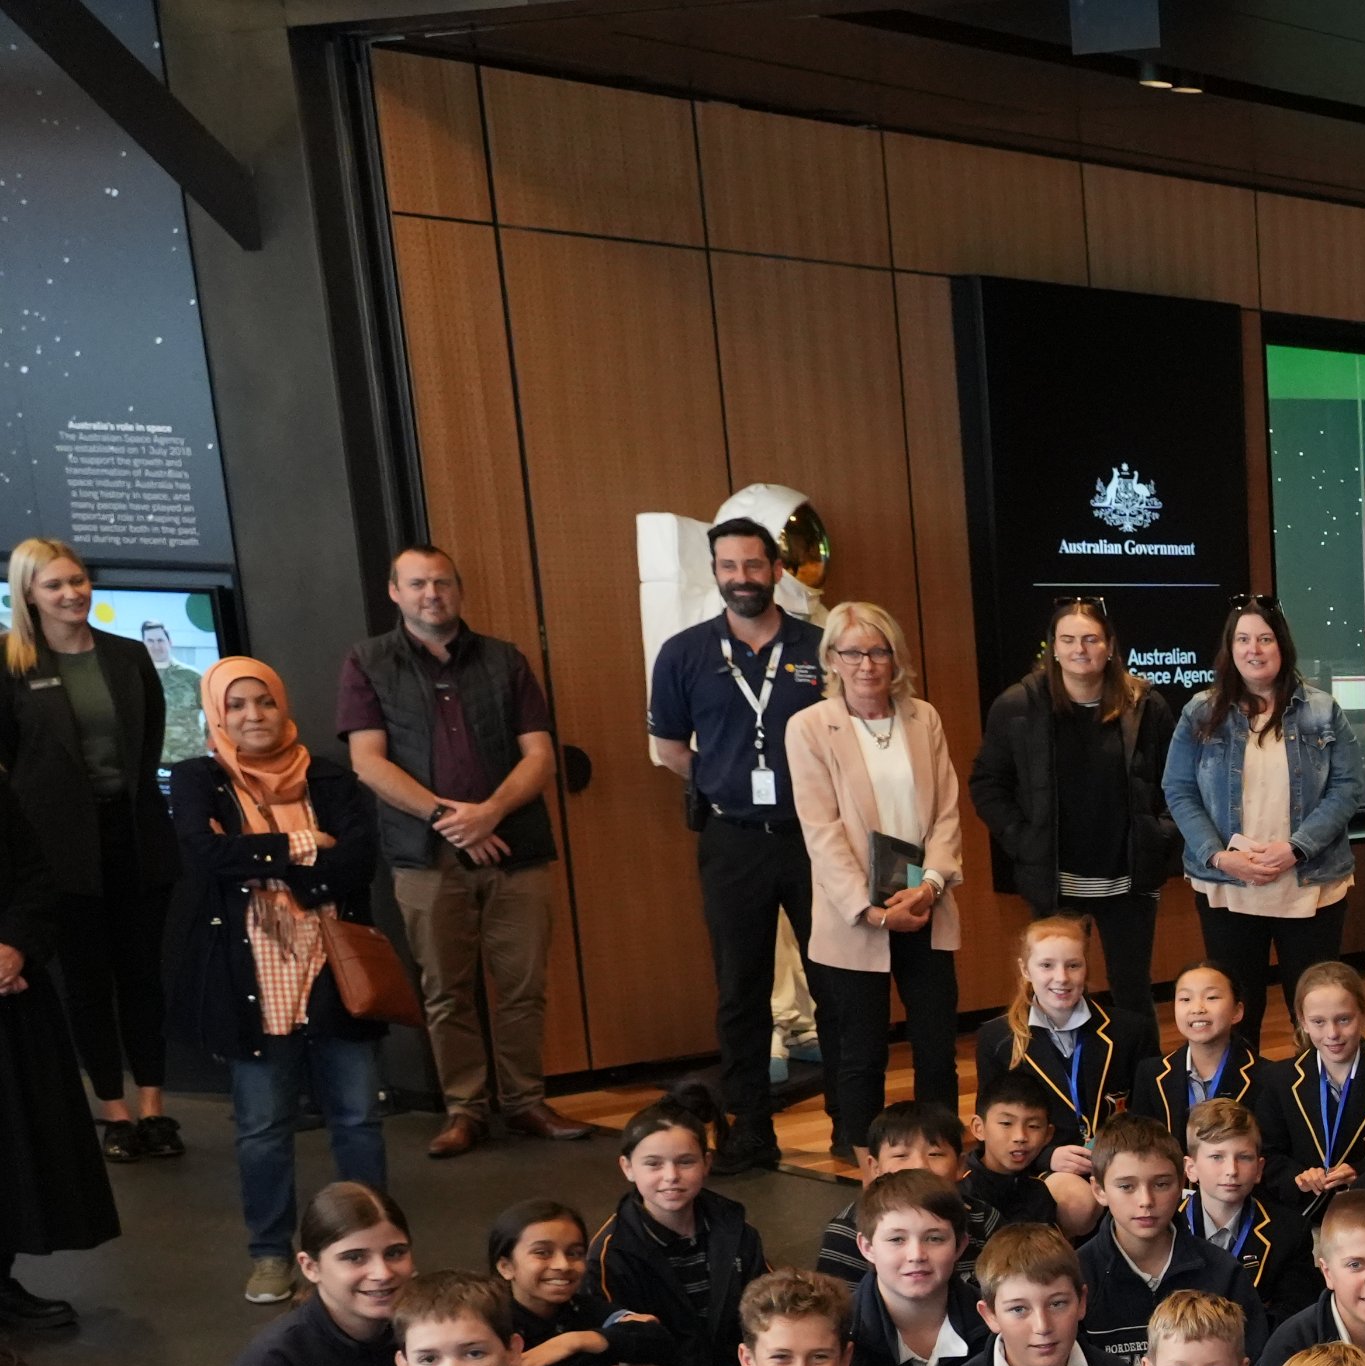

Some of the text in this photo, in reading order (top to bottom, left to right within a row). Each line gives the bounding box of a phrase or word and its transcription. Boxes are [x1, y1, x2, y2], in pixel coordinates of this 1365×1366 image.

[146, 425, 172, 434] space
[1058, 538, 1196, 556] Australian Government
[1127, 648, 1197, 666] Australian
[1174, 666, 1216, 688] Agenc
